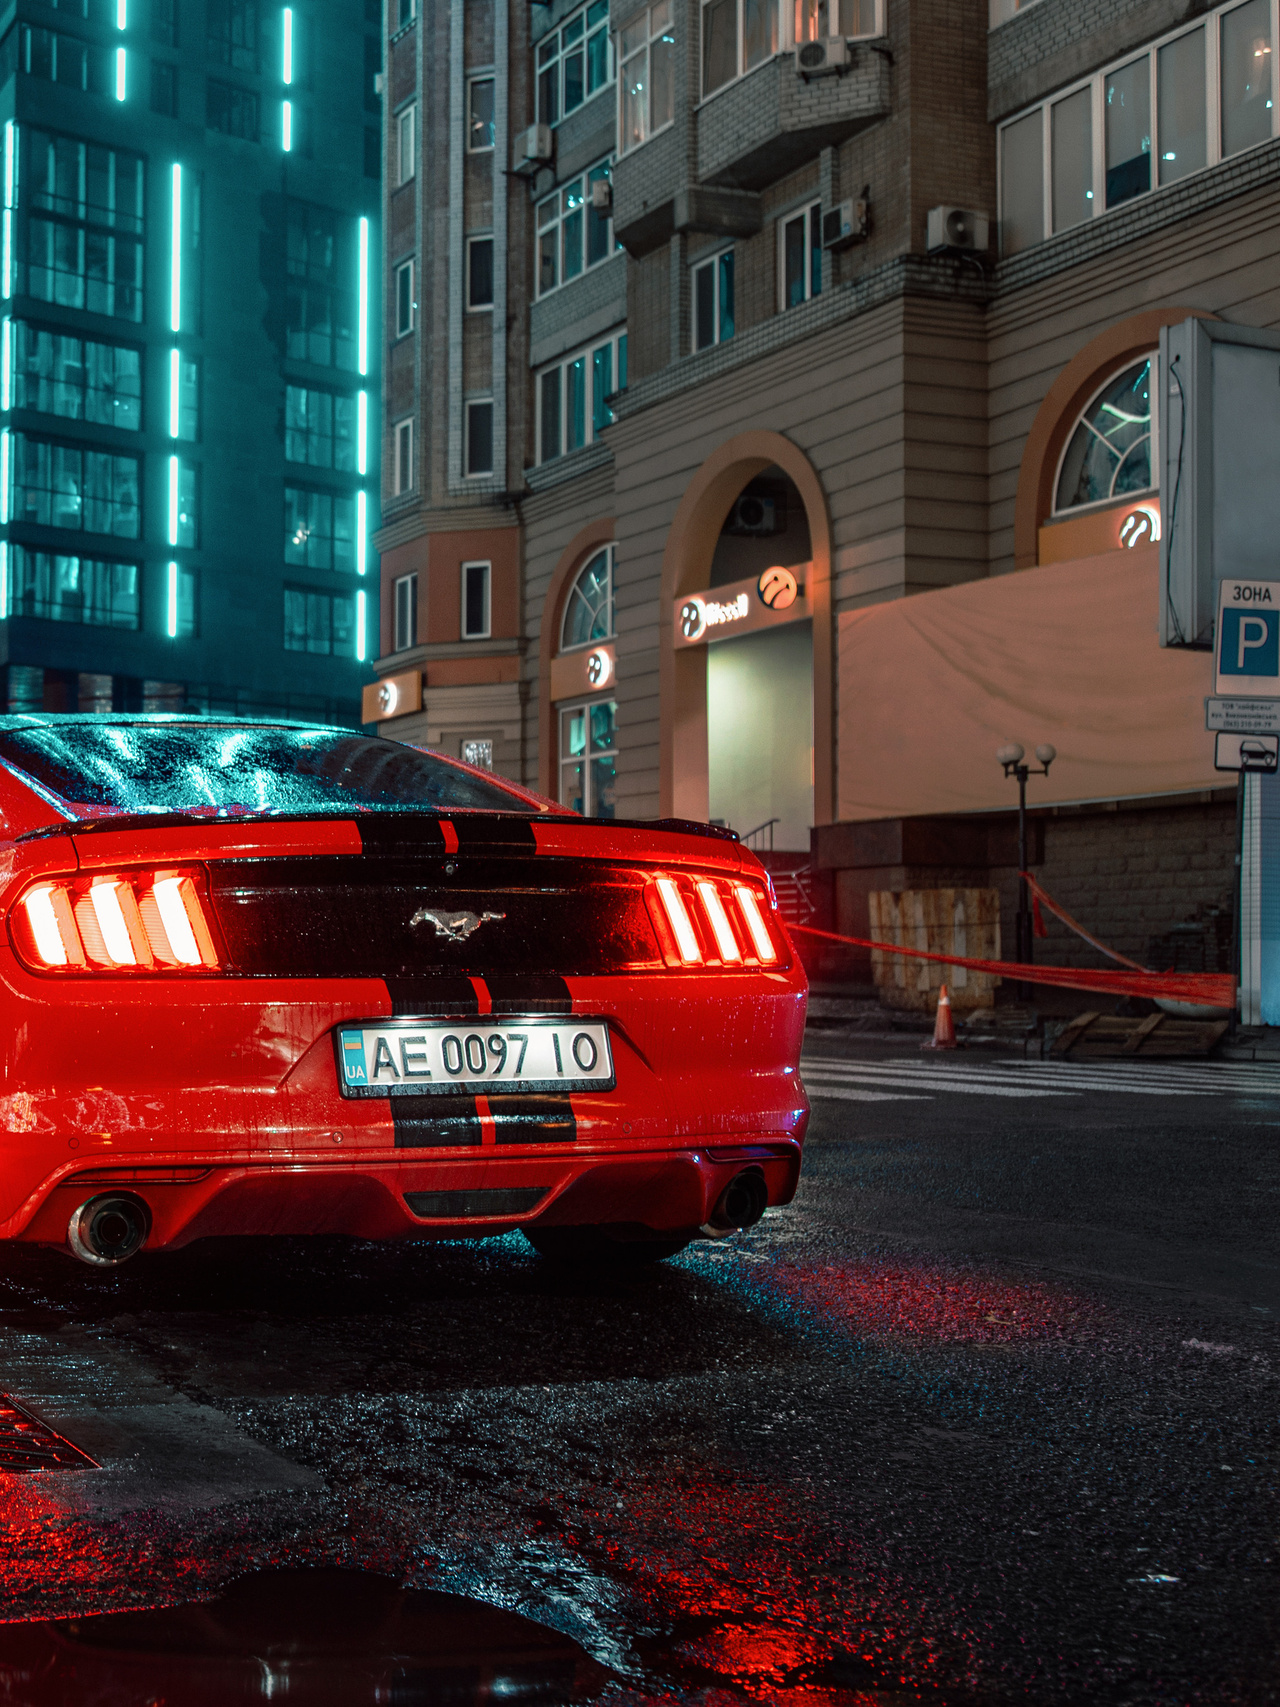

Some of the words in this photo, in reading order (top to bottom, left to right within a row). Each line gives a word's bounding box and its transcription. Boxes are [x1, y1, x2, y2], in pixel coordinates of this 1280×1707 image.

[1232, 585, 1272, 602] ЗОНА
[1237, 616, 1268, 669] P
[372, 1035, 431, 1078] AE
[441, 1032, 529, 1075] 0097
[346, 1065, 366, 1079] UA
